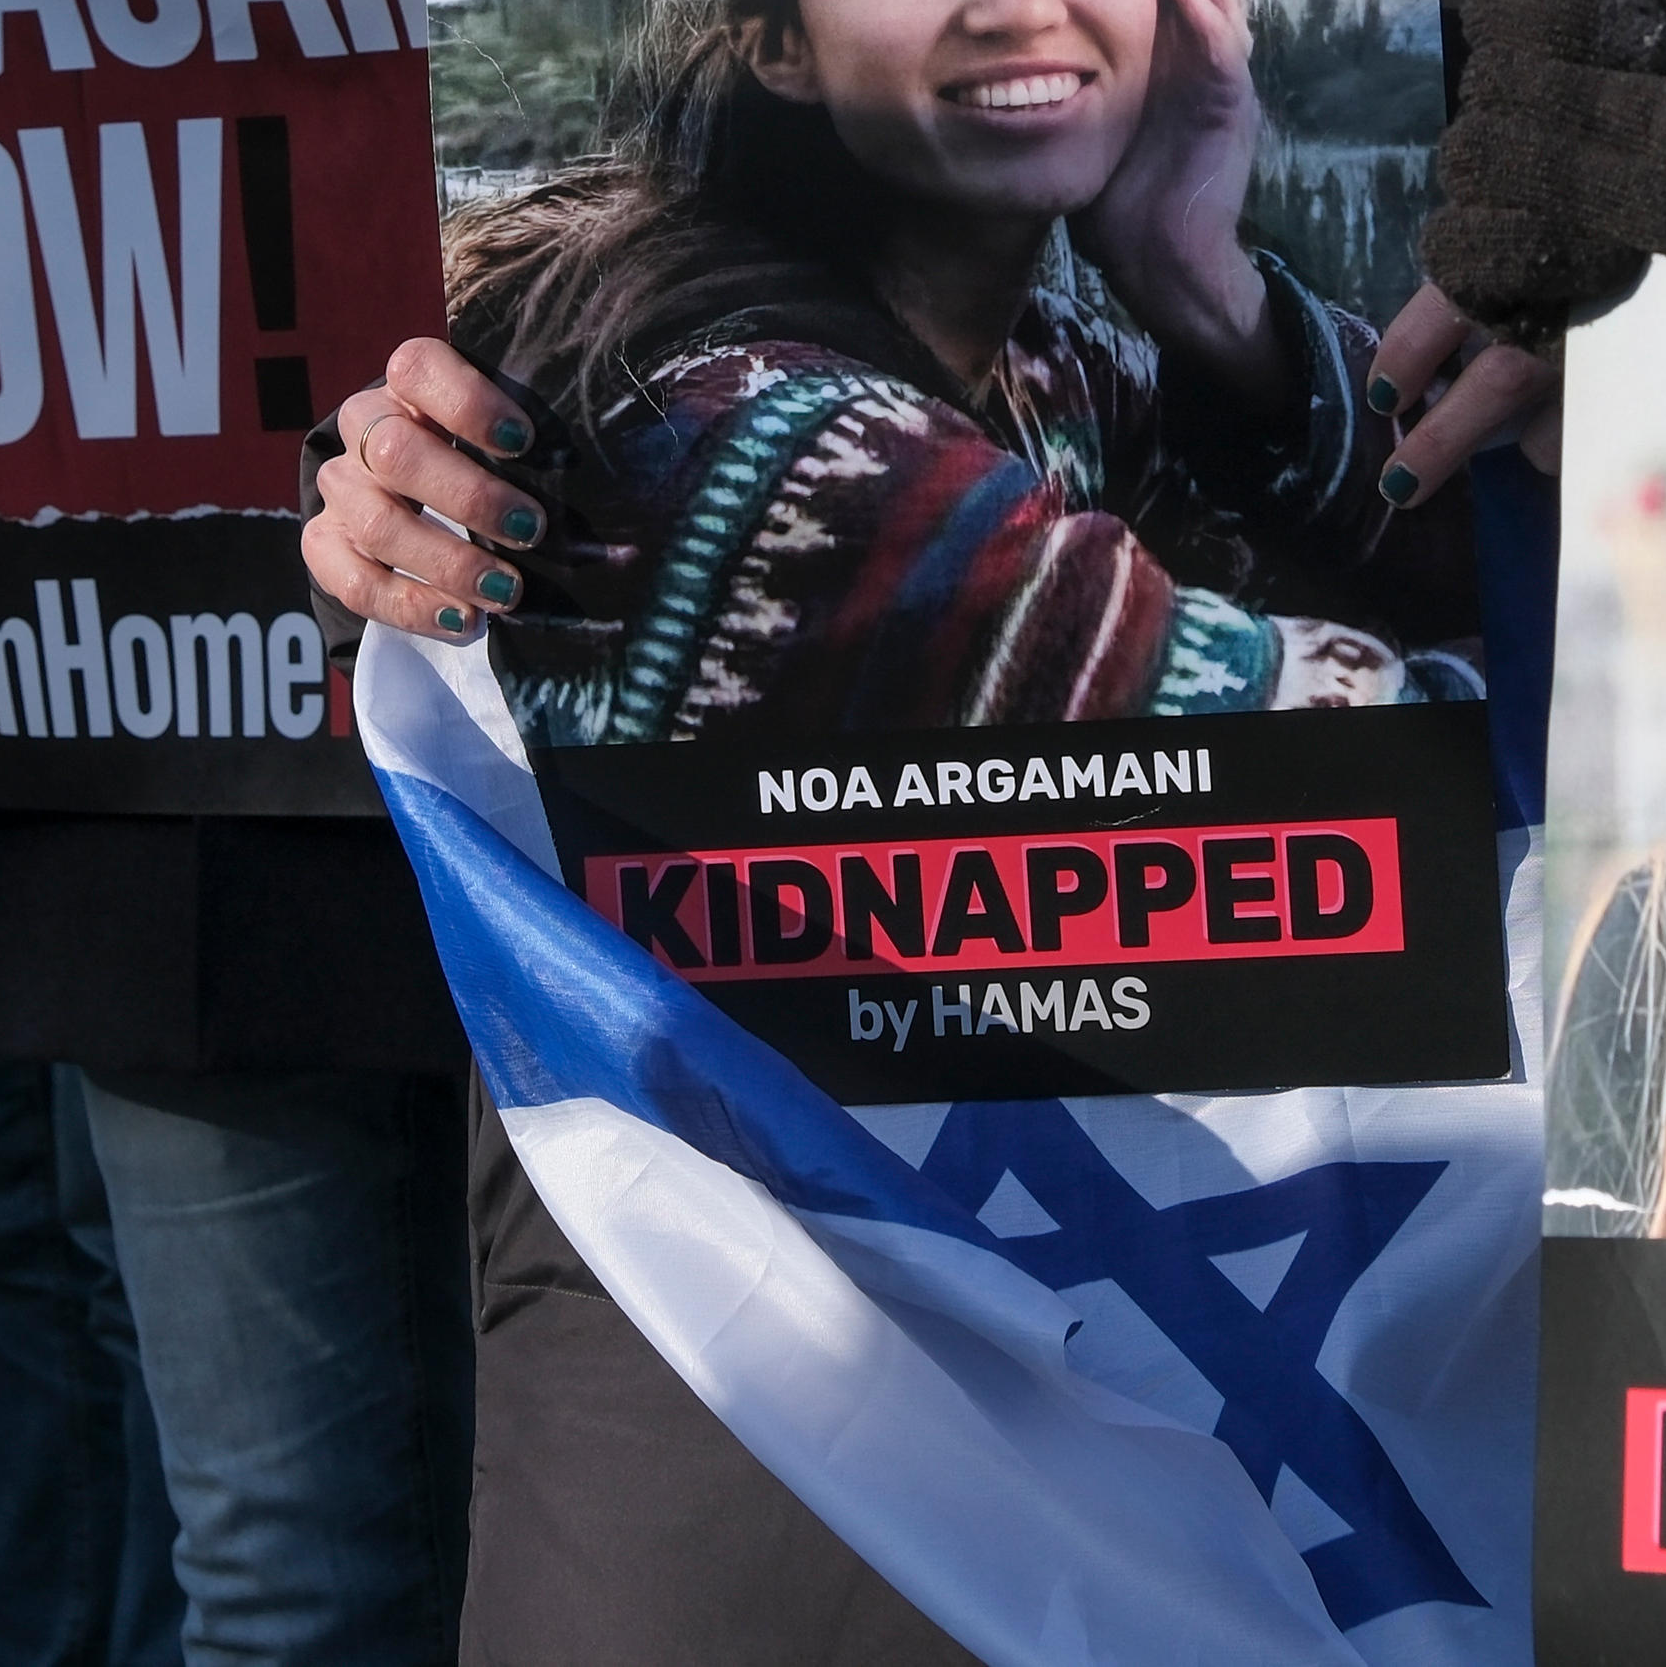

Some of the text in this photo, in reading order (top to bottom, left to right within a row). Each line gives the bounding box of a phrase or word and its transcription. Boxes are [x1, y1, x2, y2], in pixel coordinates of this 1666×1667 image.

[758, 748, 1212, 814] NOA ARGAMANI
[616, 829, 1374, 969] KIDNAPPED
[848, 976, 1151, 1052] by HAMAS
